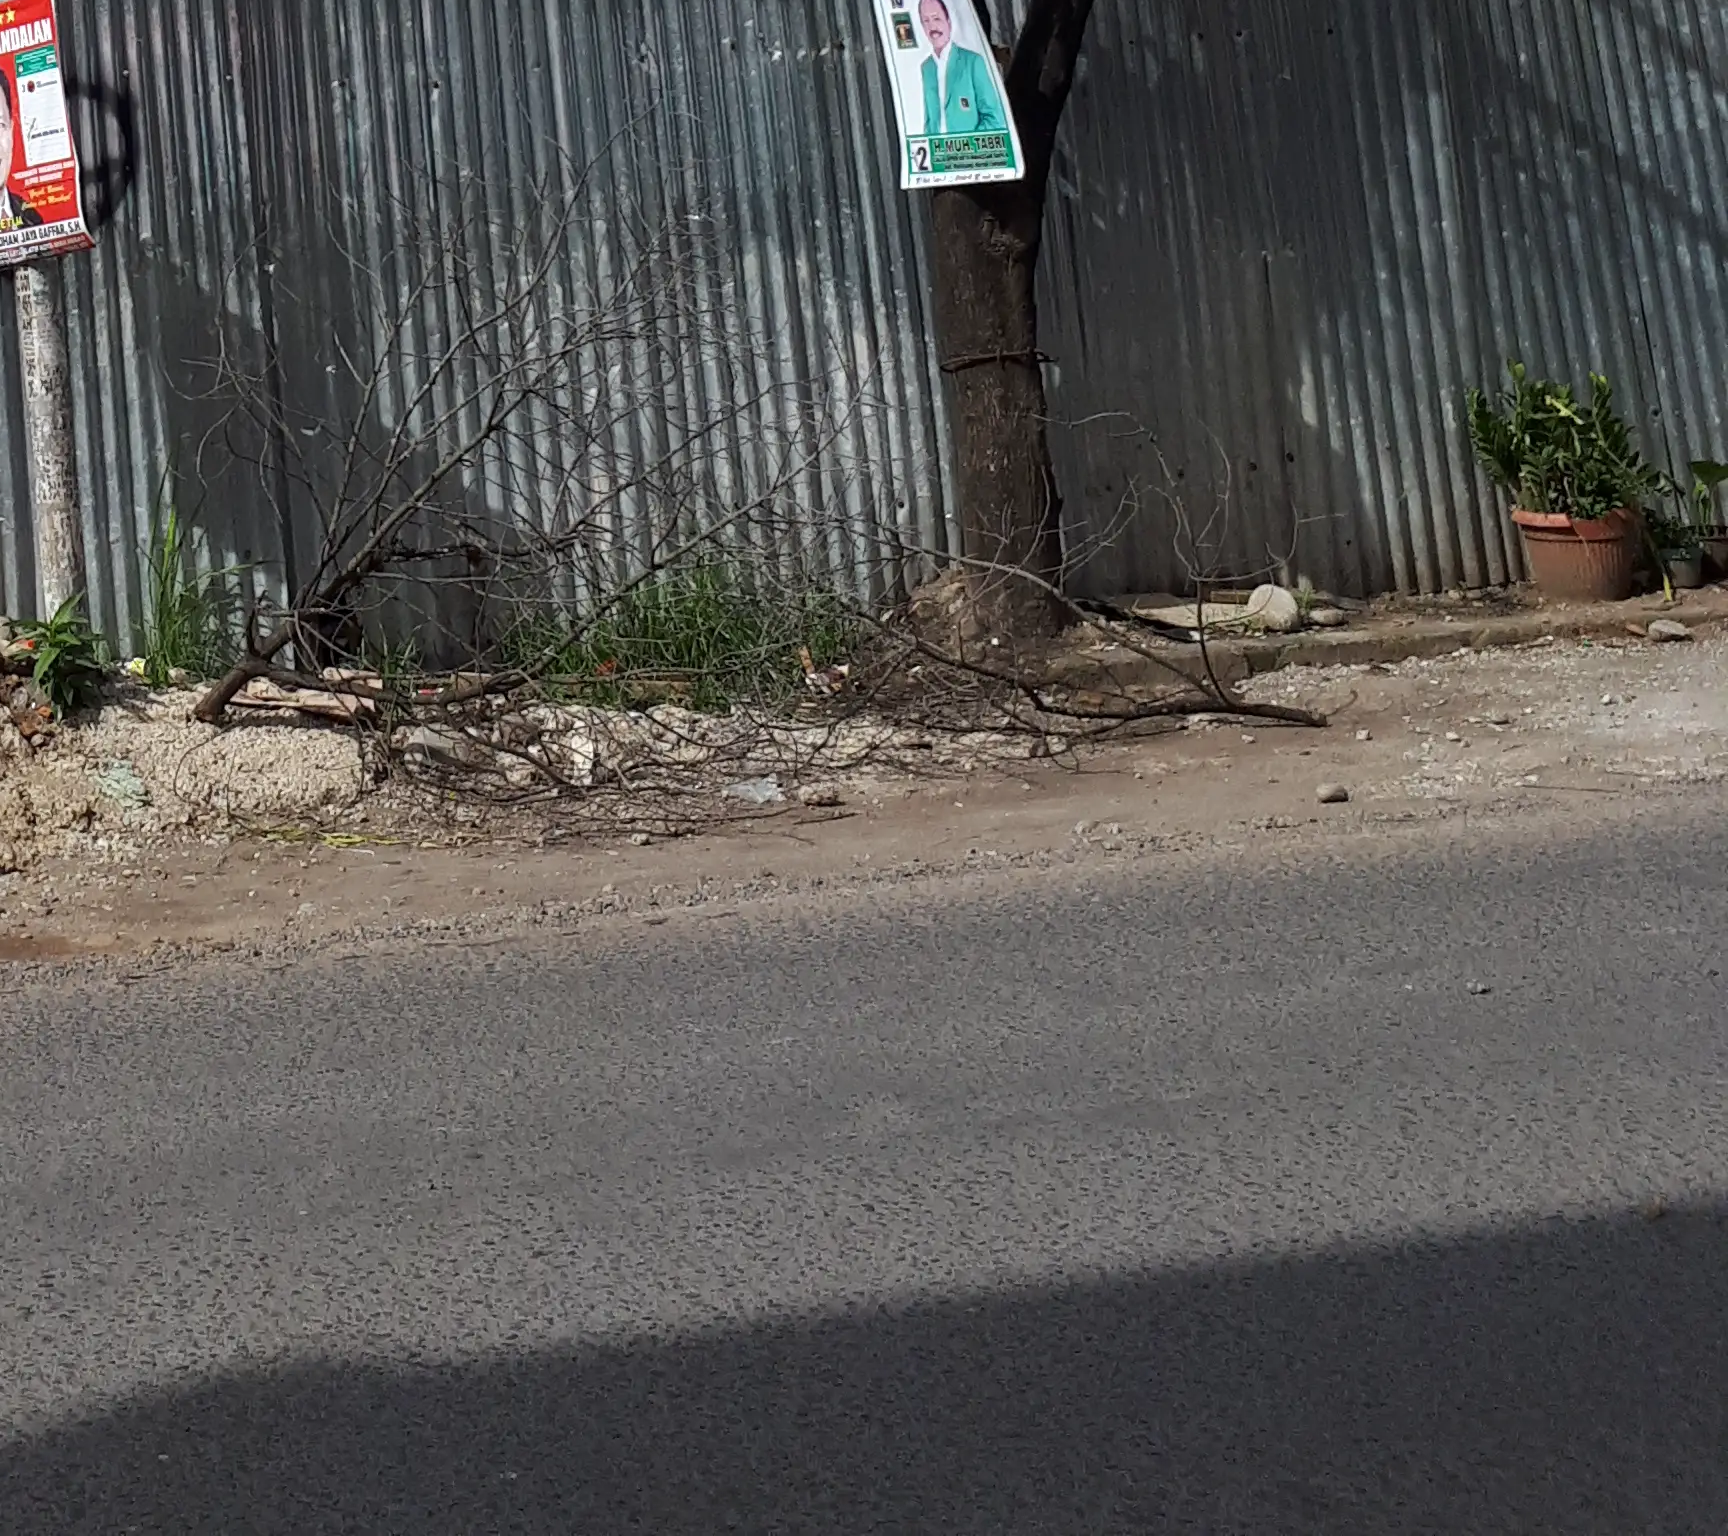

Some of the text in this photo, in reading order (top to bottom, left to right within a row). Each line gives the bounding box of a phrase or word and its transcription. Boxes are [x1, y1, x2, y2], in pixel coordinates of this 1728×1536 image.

[945, 138, 974, 153] MUH.
[974, 135, 1006, 150] TABRI
[917, 146, 929, 171] 2
[21, 231, 38, 244] JAYA
